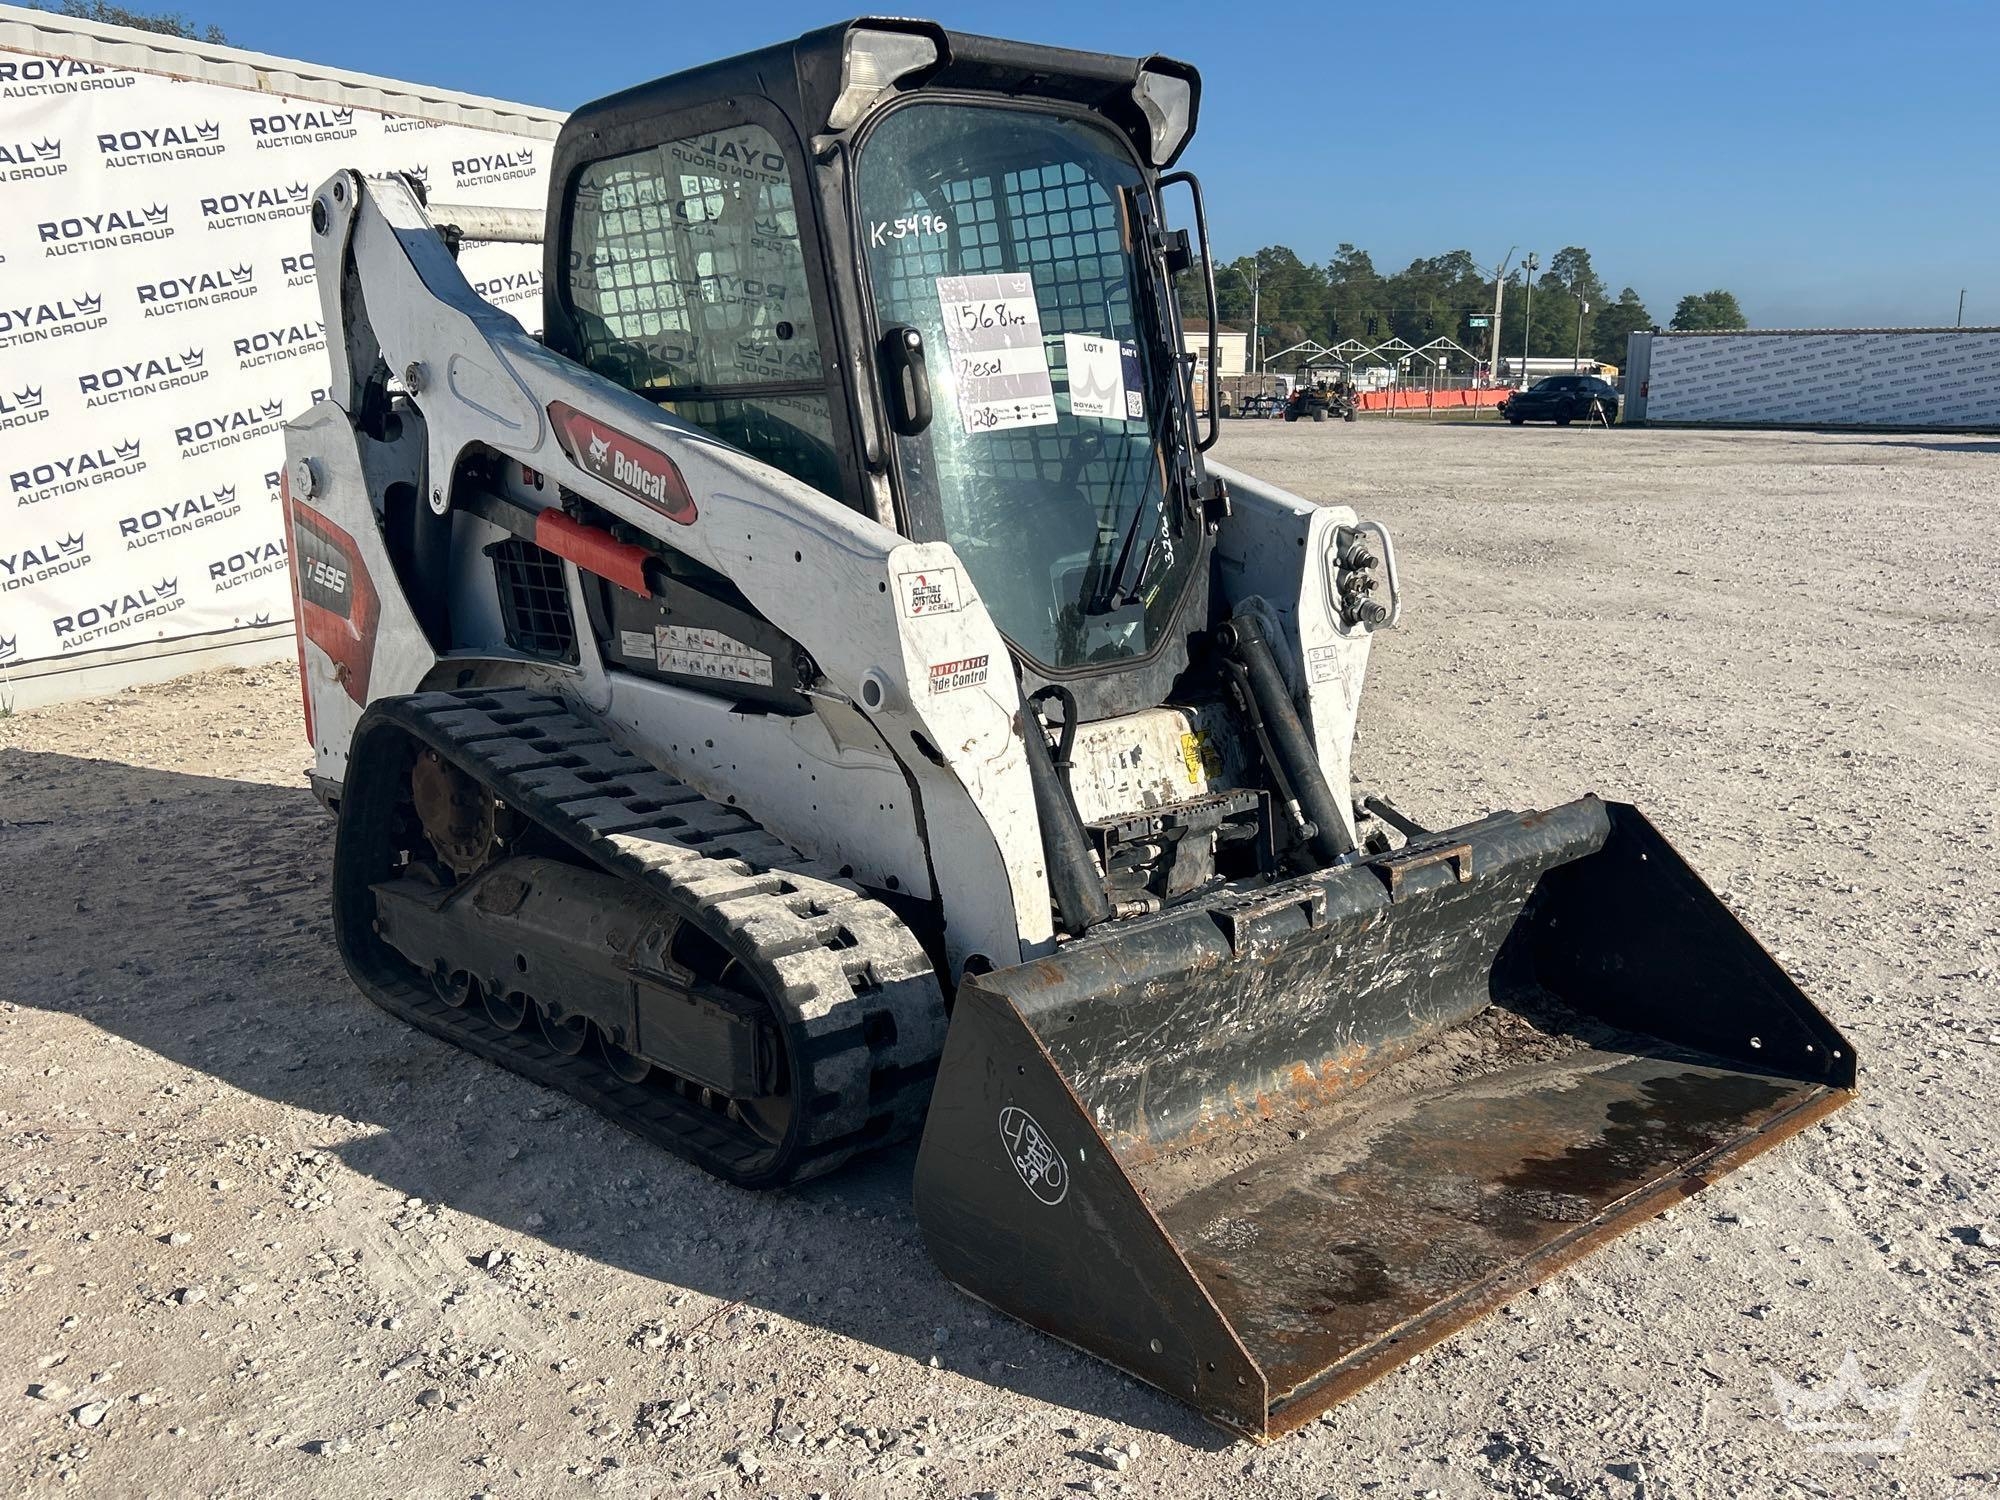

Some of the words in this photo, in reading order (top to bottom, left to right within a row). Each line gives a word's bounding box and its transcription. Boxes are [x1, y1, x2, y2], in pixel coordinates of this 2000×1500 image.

[3, 81, 77, 99] AUCTION
[81, 76, 136, 91] GROUP
[250, 111, 334, 136] ROYAL
[384, 120, 432, 134] AUCTION
[97, 126, 197, 153] ROYAL
[256, 133, 312, 150] AUCTION
[315, 129, 357, 142] GROUP
[105, 150, 174, 169] AUCTION
[176, 145, 225, 160] GROUP
[451, 152, 518, 177] ROYAL
[10, 164, 68, 182] GROUP
[456, 173, 500, 188] AUCTION
[503, 167, 537, 181] GROUP
[200, 188, 288, 216] ROYAL
[207, 211, 266, 231] AUCTION
[269, 204, 312, 220] GROUP
[37, 210, 145, 243] ROYAL
[45, 235, 118, 258] AUCTION
[120, 227, 175, 246] GROUP
[136, 270, 232, 304] ROYAL
[474, 271, 540, 296] ROYAL
[489, 293, 523, 307] CTION
[525, 286, 544, 298] GRO
[0, 301, 76, 332] OYAL
[144, 295, 209, 319] AUCTION
[211, 286, 258, 304] GROUP
[0, 329, 48, 348] CTION
[51, 317, 107, 337] GROUP
[233, 322, 318, 358] ROYAL
[1084, 342, 1098, 352] LOT
[239, 347, 297, 370] AUCTION
[299, 339, 328, 355] GRO
[1121, 347, 1133, 357] DAY
[78, 356, 183, 394] ROYAL
[86, 384, 156, 408] AUCTION
[159, 370, 209, 391] GROUP
[0, 409, 50, 431] ROUP
[1074, 401, 1097, 409] ROYAL
[174, 408, 263, 446] ROYAL
[181, 435, 241, 460] AUCTION
[243, 420, 288, 441] GROUP
[9, 449, 117, 492] ROYAL
[17, 477, 89, 507] AUCTION
[92, 461, 147, 485] GROUP
[613, 450, 667, 503] Bobcat
[119, 494, 215, 538] ROYAL
[126, 521, 193, 552] AUCTION
[195, 505, 241, 528] GROUP
[0, 544, 59, 575] YAL
[36, 555, 91, 582] GROUP
[306, 556, 347, 594] T595
[215, 564, 273, 593] AUCTION
[52, 589, 156, 637] ROYAL
[62, 619, 132, 651] AUCTION
[134, 598, 186, 624] GROUP
[952, 668, 988, 687] Control
